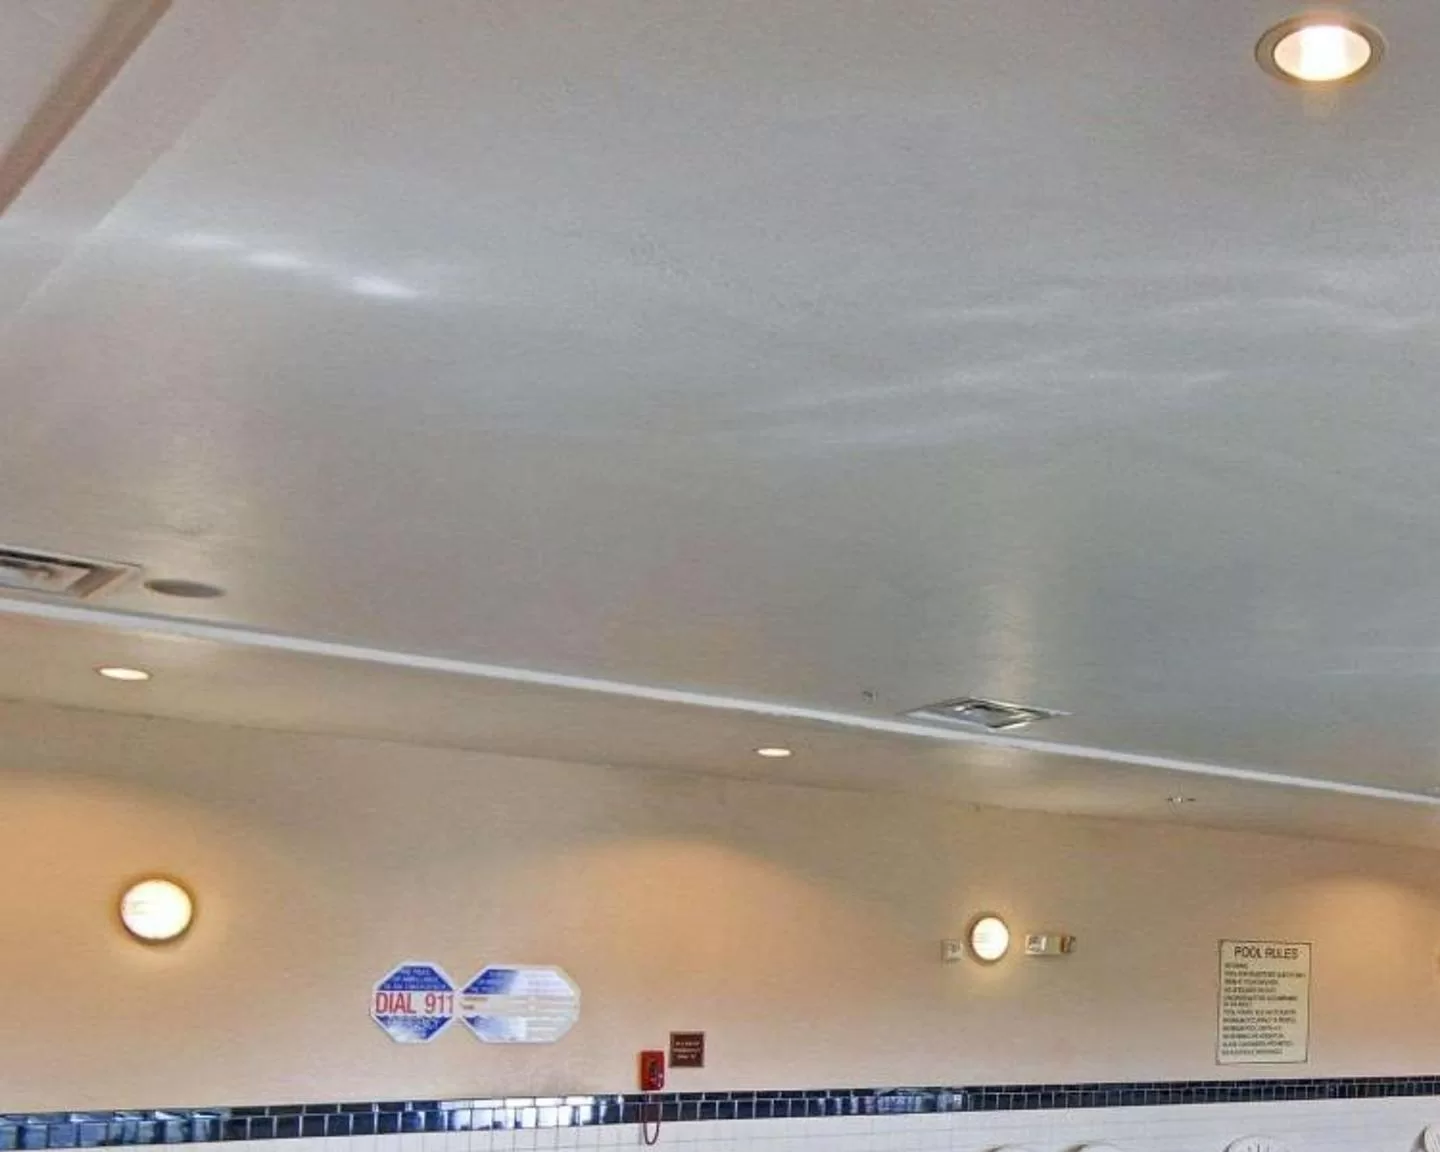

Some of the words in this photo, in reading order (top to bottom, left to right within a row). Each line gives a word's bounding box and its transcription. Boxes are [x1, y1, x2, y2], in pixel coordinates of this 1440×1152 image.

[1234, 946, 1262, 959] POOL
[1264, 948, 1299, 960] RULES
[375, 992, 417, 1015] DIAL
[424, 992, 454, 1015] 911
